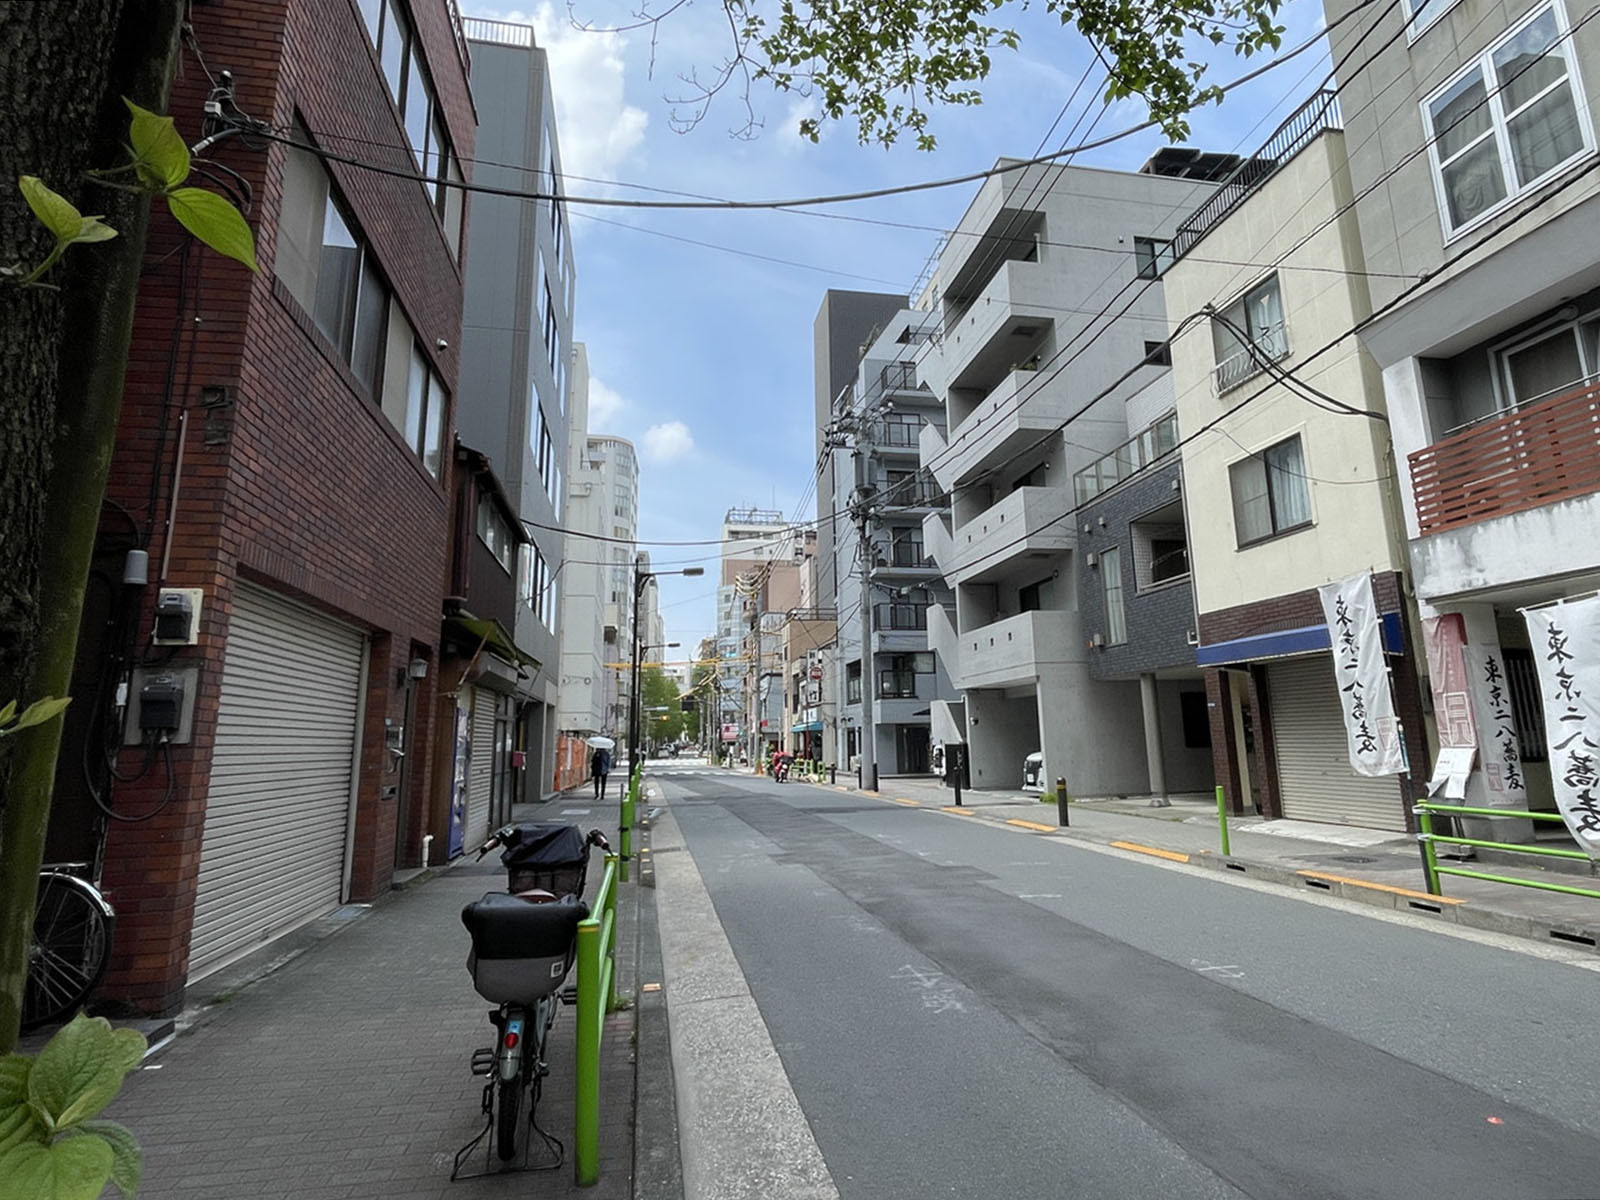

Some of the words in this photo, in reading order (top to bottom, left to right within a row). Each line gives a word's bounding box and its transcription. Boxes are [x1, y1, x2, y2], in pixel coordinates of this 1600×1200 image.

[1484, 655, 1525, 791] 東京二八蕎麦
[1548, 622, 1600, 835] 東京二八蕎麦
